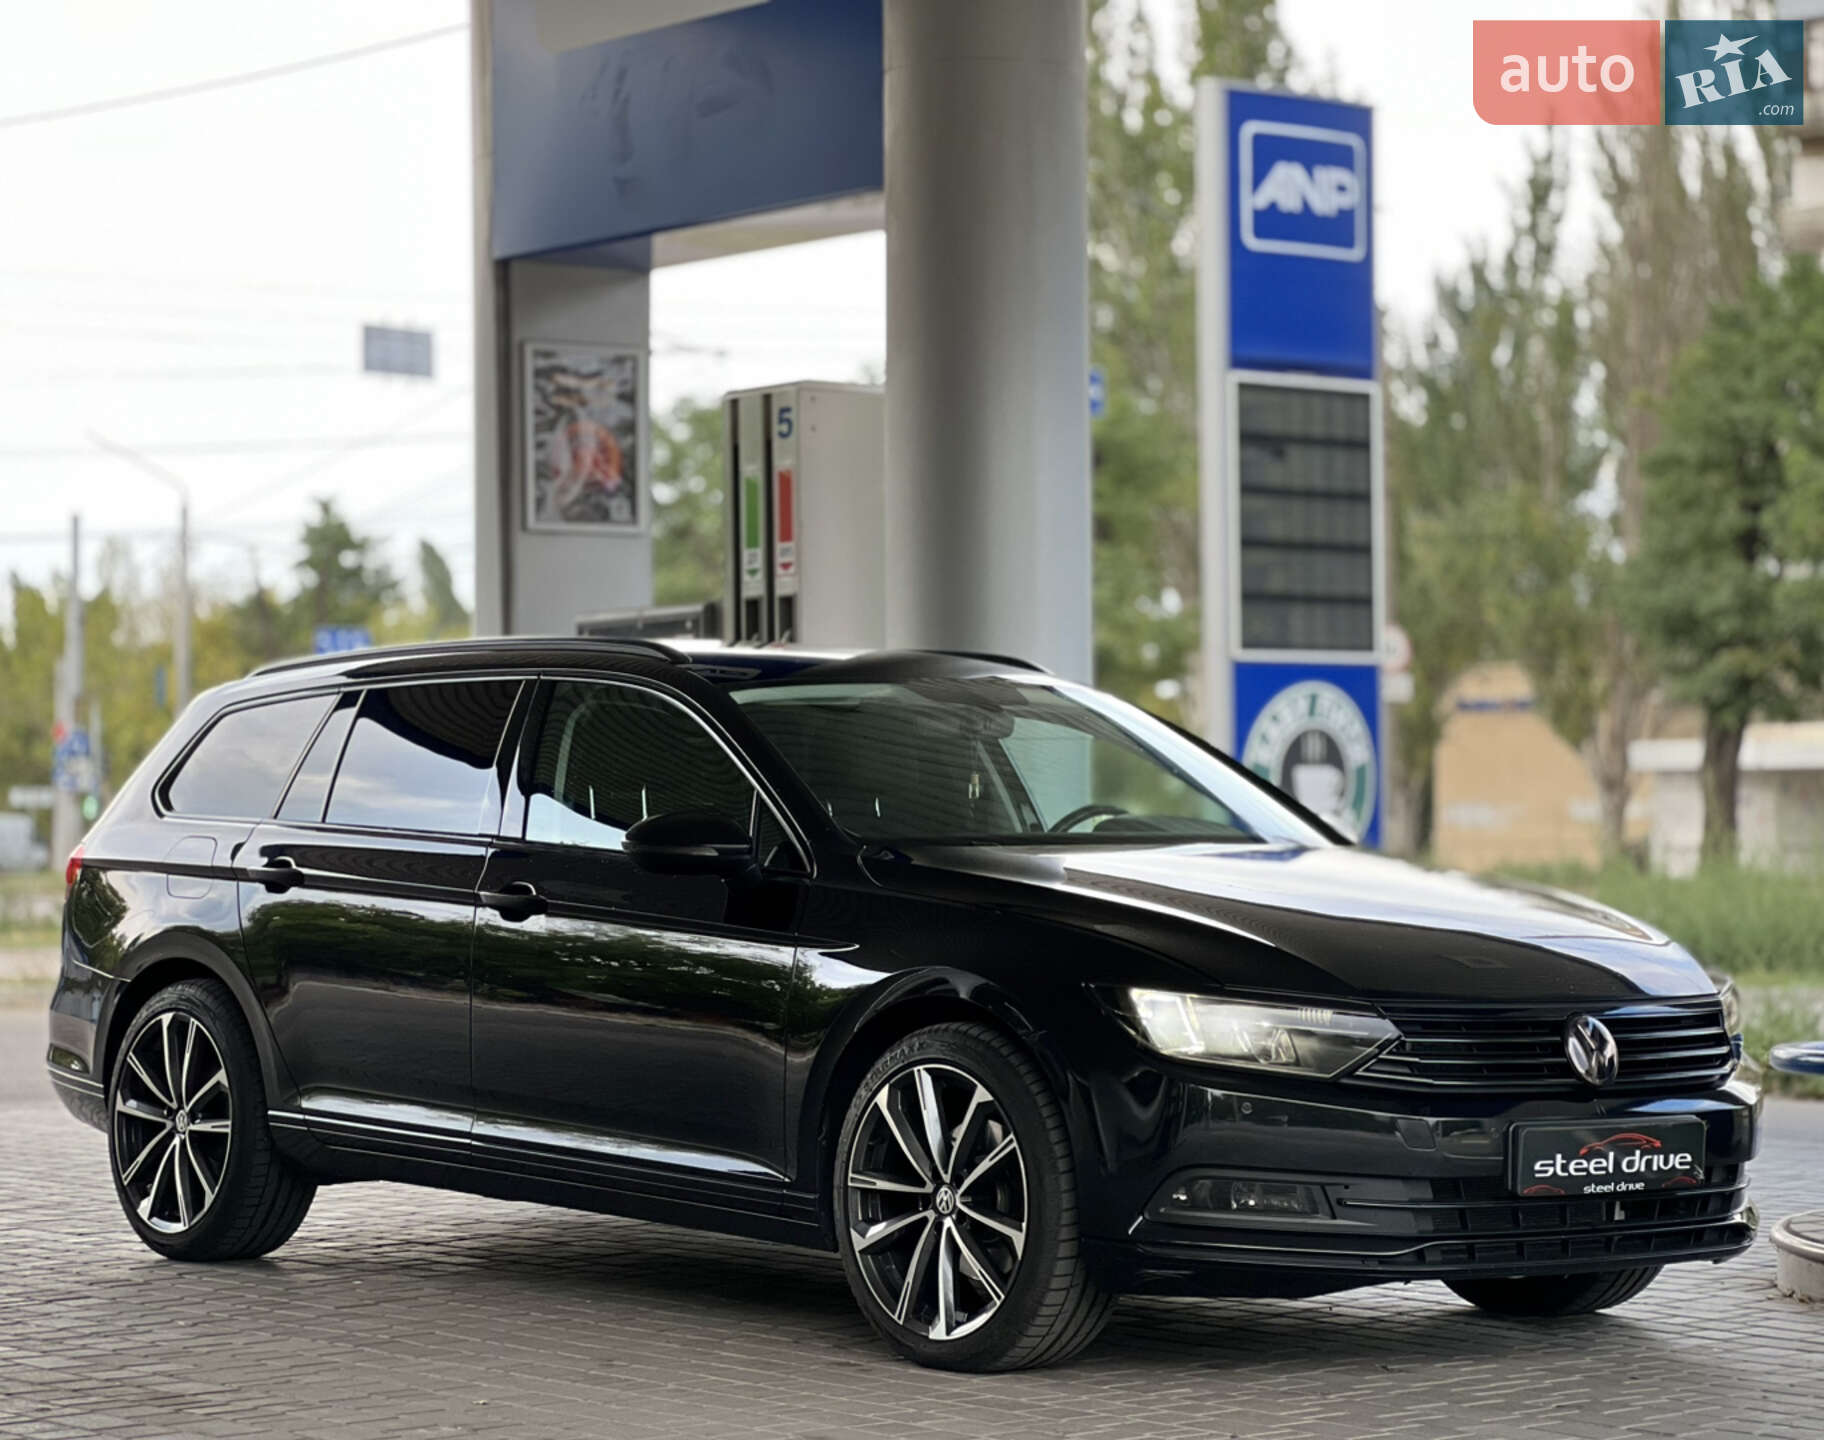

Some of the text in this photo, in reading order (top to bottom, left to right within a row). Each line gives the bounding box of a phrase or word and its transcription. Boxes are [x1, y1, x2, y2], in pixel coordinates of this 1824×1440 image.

[1252, 160, 1361, 218] ANP
[777, 407, 794, 439] 5
[1533, 1149, 1693, 1178] steel drive
[1583, 1180, 1645, 1194] steel drive
